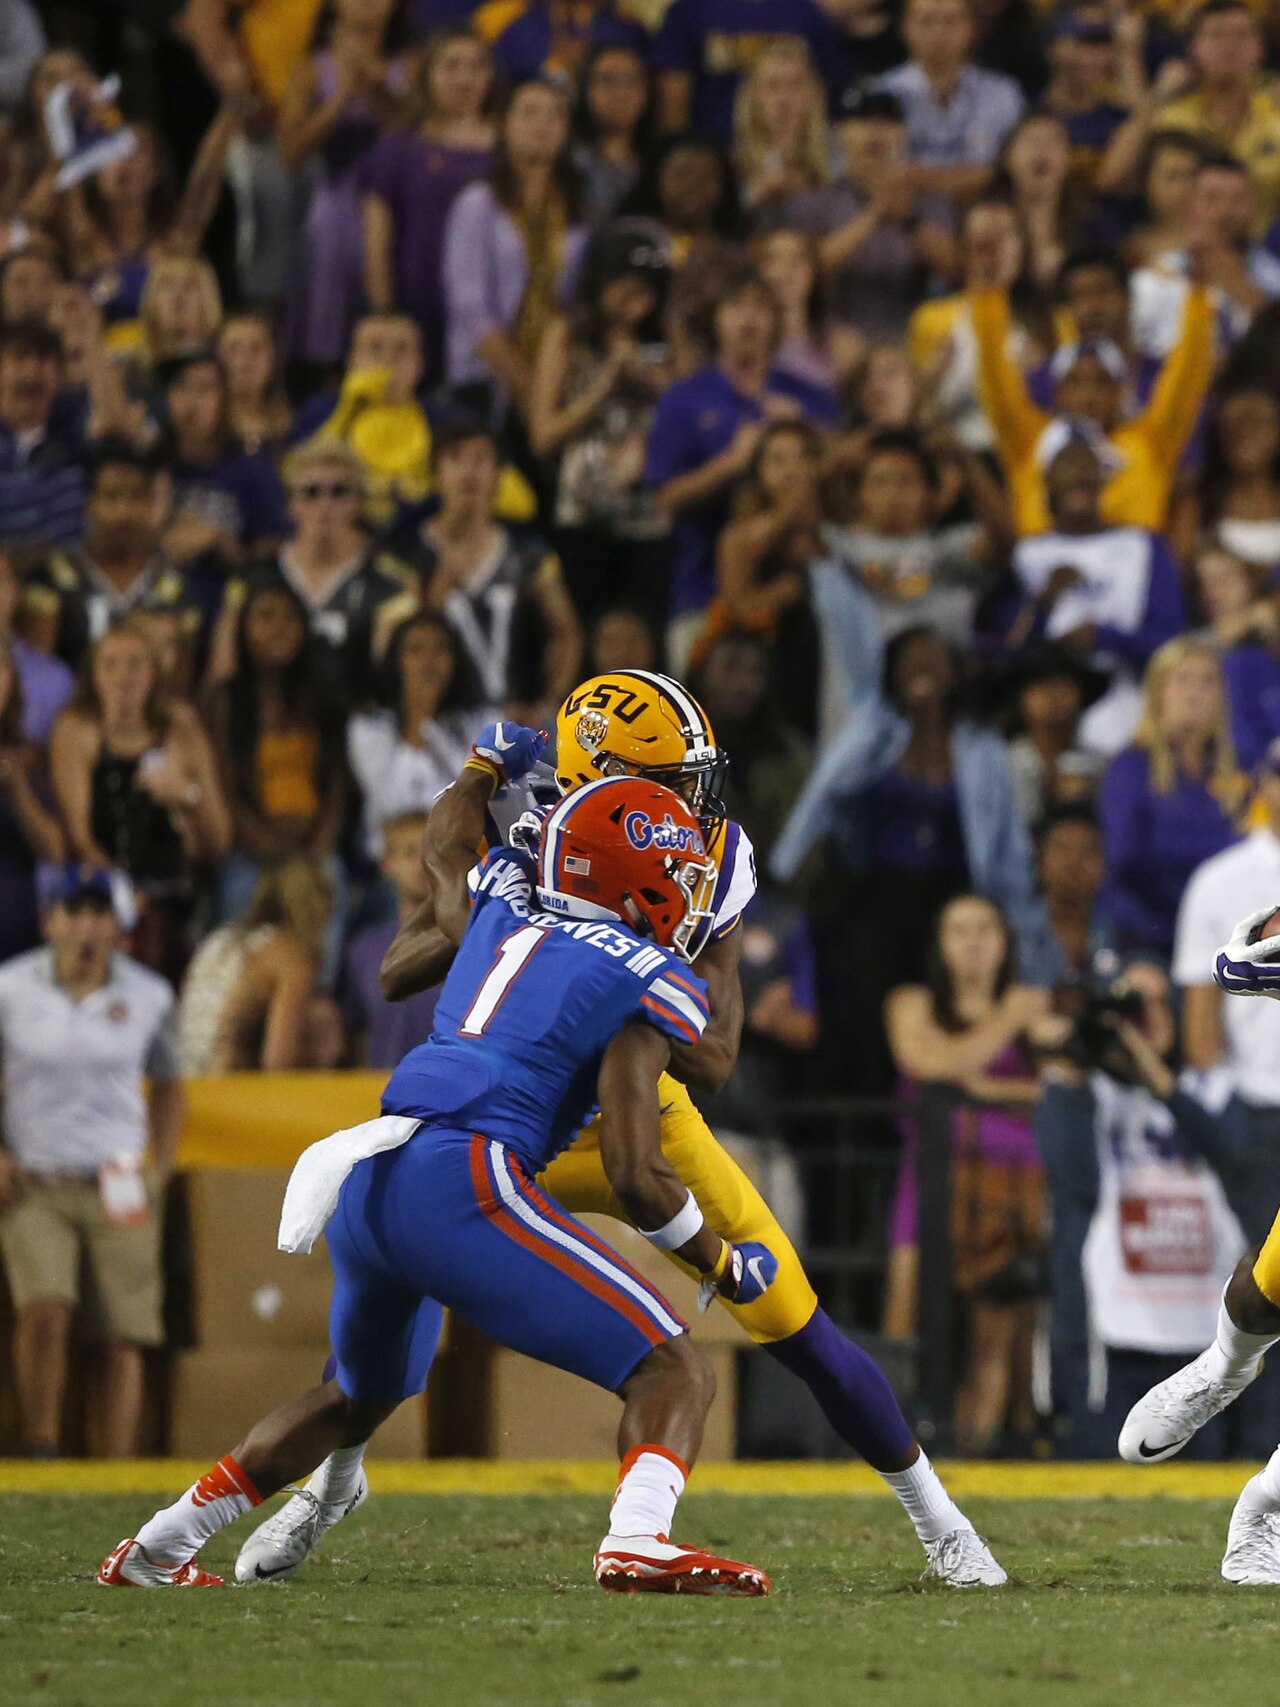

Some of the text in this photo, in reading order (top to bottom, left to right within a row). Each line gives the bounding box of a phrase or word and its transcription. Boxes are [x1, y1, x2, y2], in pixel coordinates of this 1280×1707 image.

[565, 684, 649, 724] LSU
[457, 925, 552, 1038] 1
[624, 945, 668, 979] III
